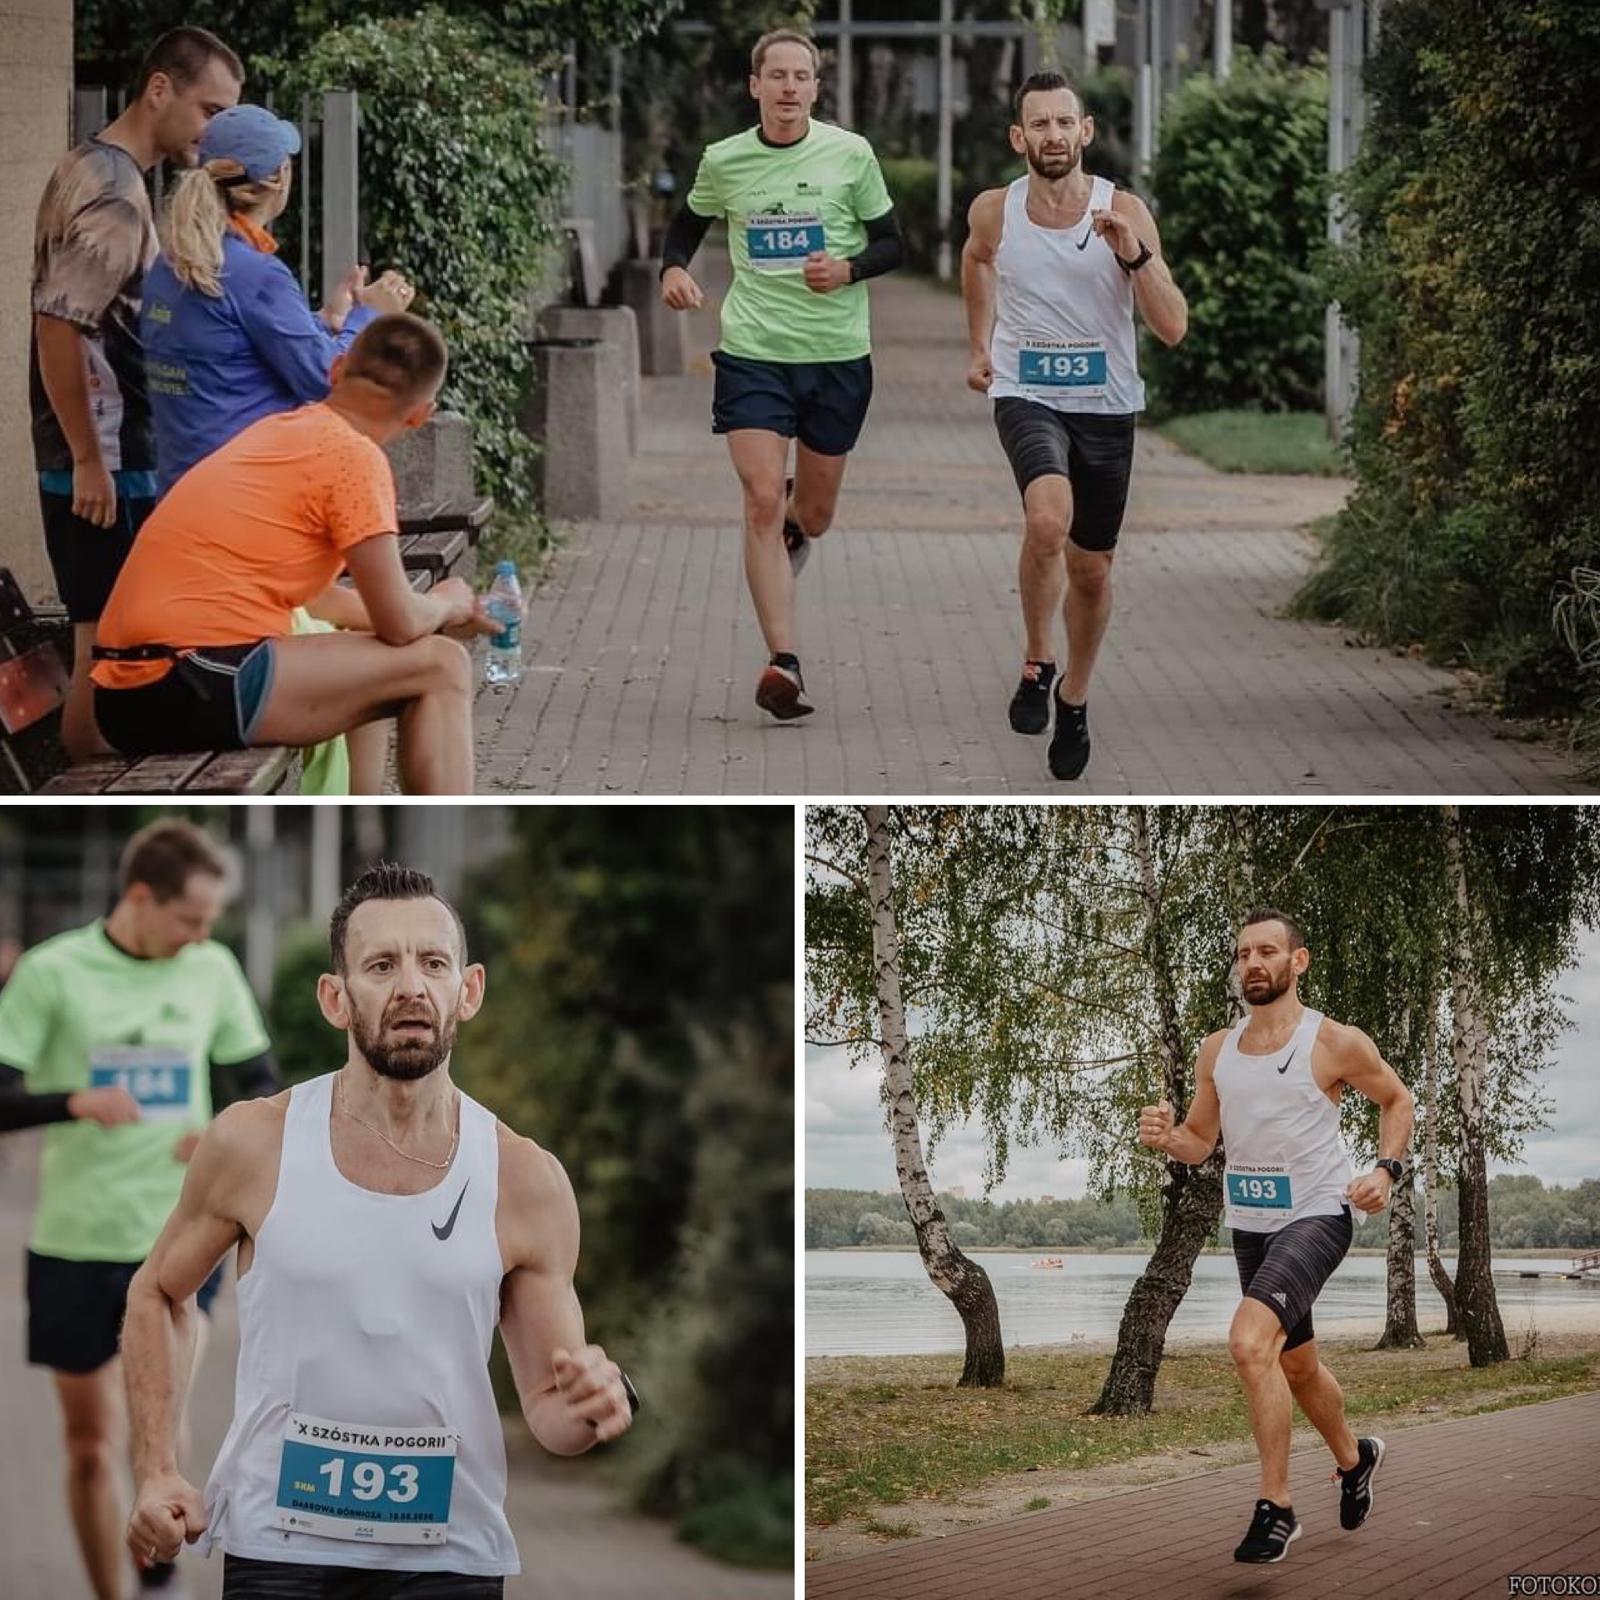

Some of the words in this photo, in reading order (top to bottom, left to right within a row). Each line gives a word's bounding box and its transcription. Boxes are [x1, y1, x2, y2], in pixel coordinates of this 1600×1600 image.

[762, 230, 810, 250] 184
[1038, 356, 1089, 377] 193
[1238, 1179, 1277, 1199] 193
[312, 1426, 380, 1447] SZÓSTKA
[384, 1436, 446, 1449] POGORII
[319, 1457, 419, 1503] 193
